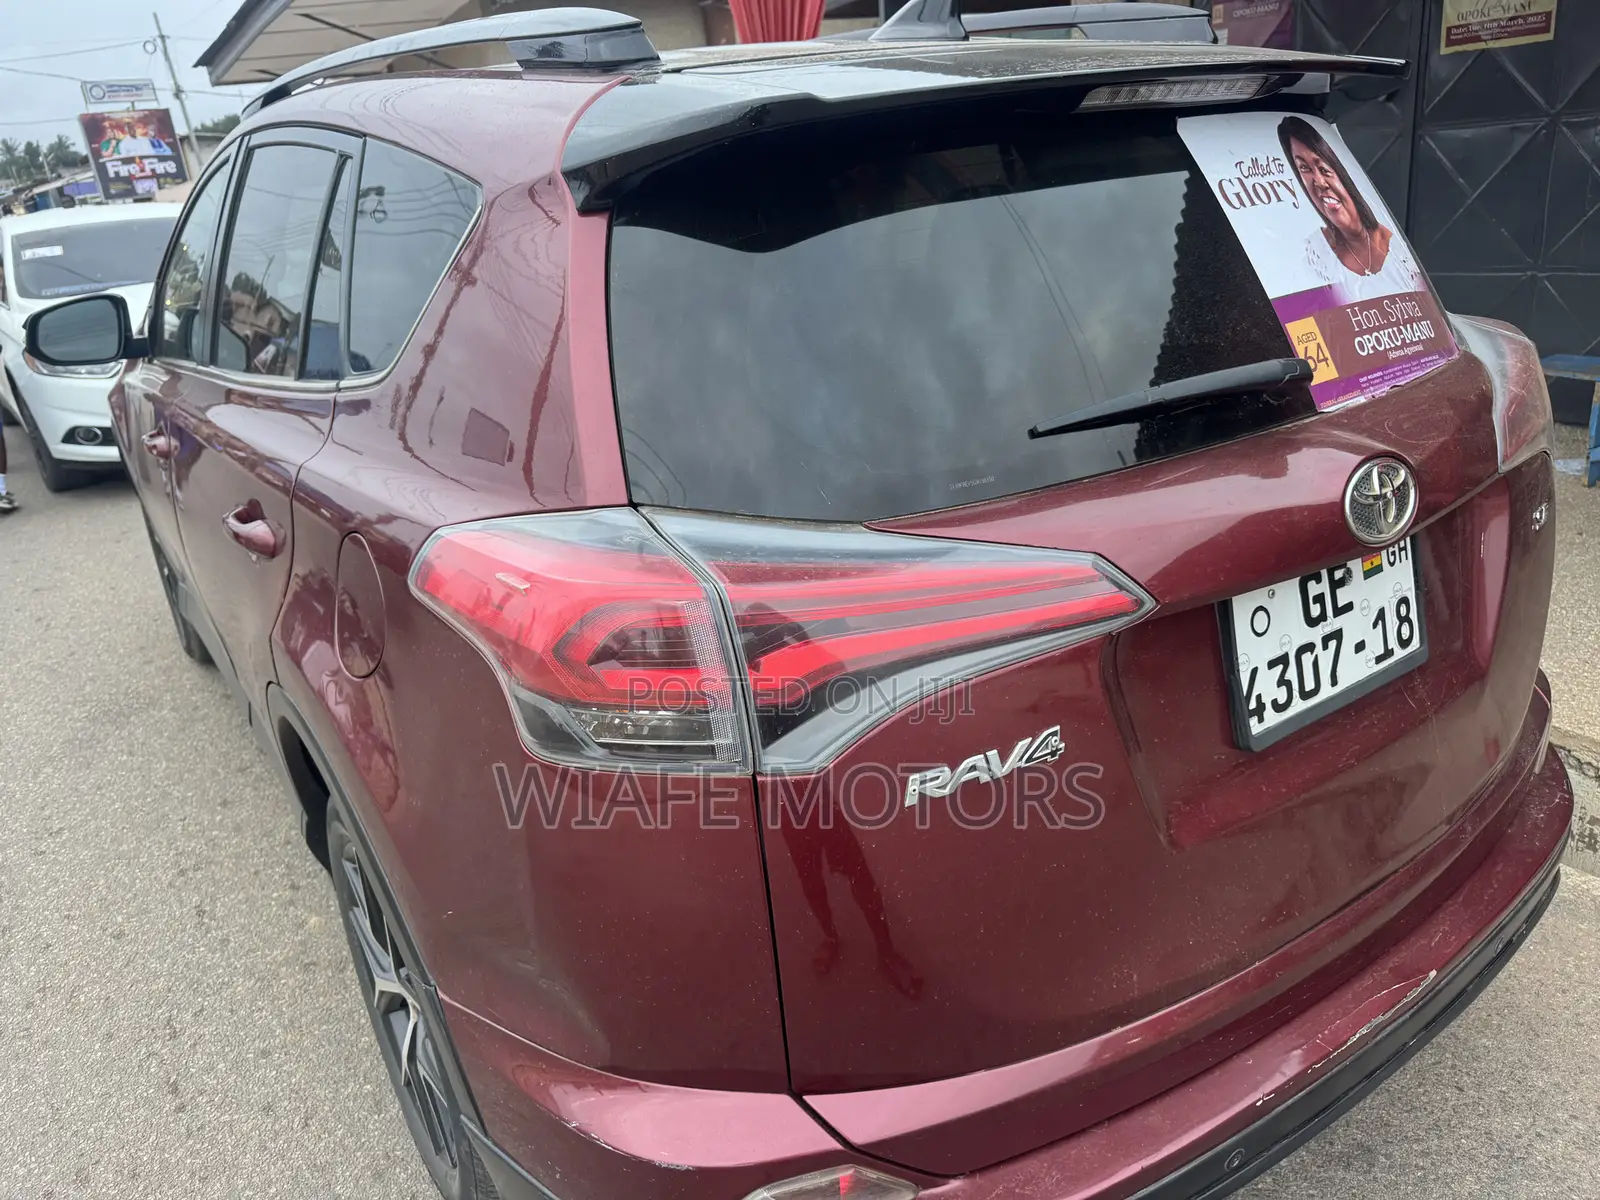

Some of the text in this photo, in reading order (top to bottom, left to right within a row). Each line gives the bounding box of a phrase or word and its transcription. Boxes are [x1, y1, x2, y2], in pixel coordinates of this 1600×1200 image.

[1527, 13, 1546, 23] 2025
[105, 157, 177, 177] Fire Fire
[1235, 156, 1284, 179] Called to
[1218, 177, 1299, 210] Glory
[1346, 297, 1421, 332] Hon. Sylvia
[1296, 331, 1317, 346] AGED
[1354, 320, 1435, 357] OPOKU-MANU
[1304, 343, 1329, 373] 64
[1299, 562, 1354, 628] GE
[1386, 540, 1408, 567] GH
[904, 724, 1065, 808] RAV4
